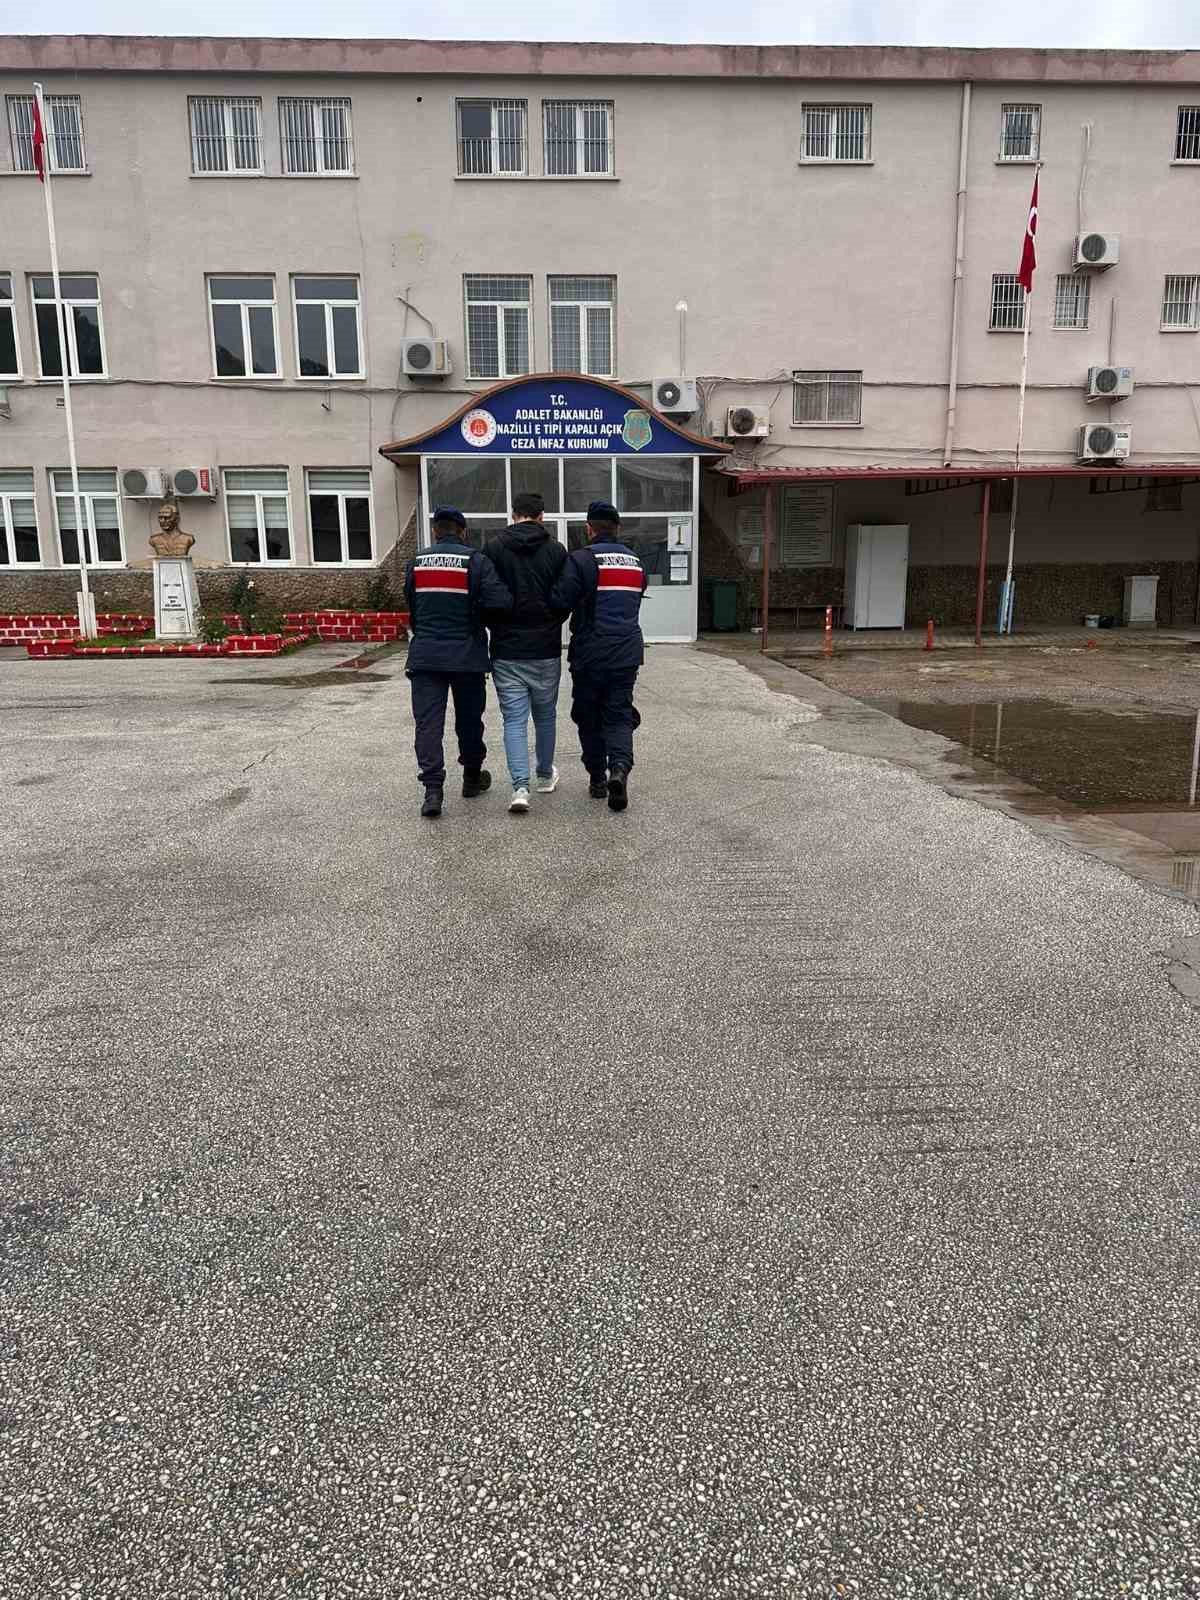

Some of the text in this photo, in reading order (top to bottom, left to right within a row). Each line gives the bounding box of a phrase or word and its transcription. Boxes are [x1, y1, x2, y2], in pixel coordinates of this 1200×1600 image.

[550, 394, 568, 406] T.C.
[515, 407, 603, 420] ADALET BAKANLIĞI
[497, 422, 623, 437] NAZİLLİ E TİPİ KAPALI AÇIK
[511, 436, 609, 449] CEZA İNFAZ KURUMU
[418, 556, 463, 568] JANDARMA
